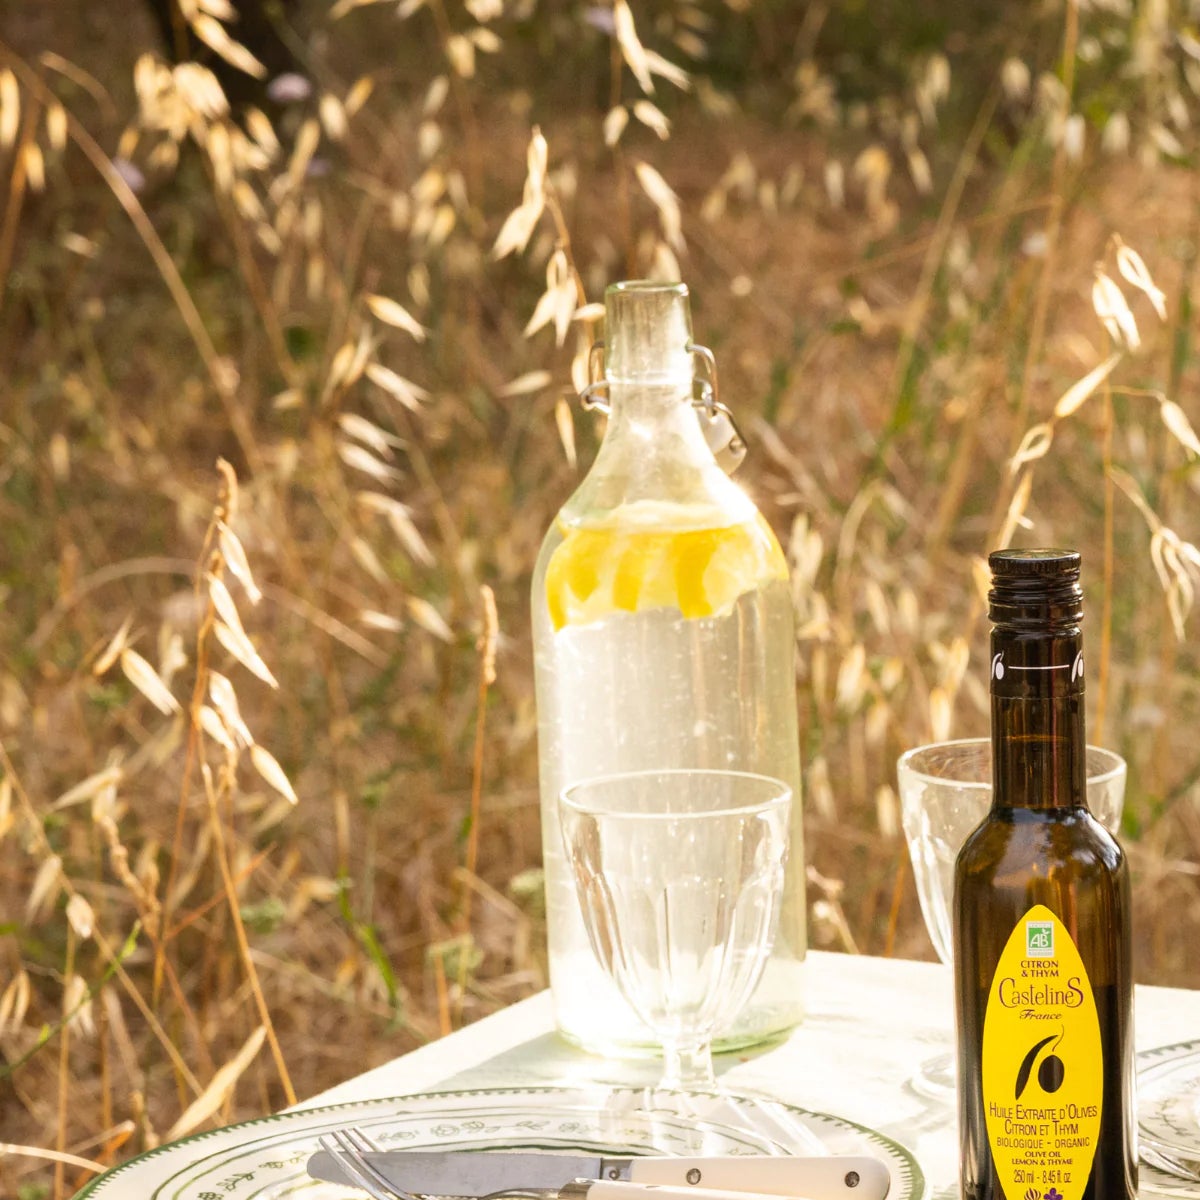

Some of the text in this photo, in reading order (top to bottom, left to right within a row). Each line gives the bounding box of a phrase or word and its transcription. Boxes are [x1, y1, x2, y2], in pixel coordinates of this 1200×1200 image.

[1030, 934, 1049, 948] AB
[1020, 960, 1059, 969] CITRON
[1030, 969, 1060, 977] THYM
[1019, 1008, 1062, 1020] France
[989, 1101, 1013, 1119] HUILE
[1016, 1104, 1057, 1120] EXTRAITE
[1004, 1118, 1037, 1135] CITRON
[1052, 1120, 1079, 1136] THYM
[996, 1137, 1043, 1149] BIOLOGIQUE
[1055, 1137, 1090, 1148] ORGANIC
[1014, 1169, 1025, 1183] 250
